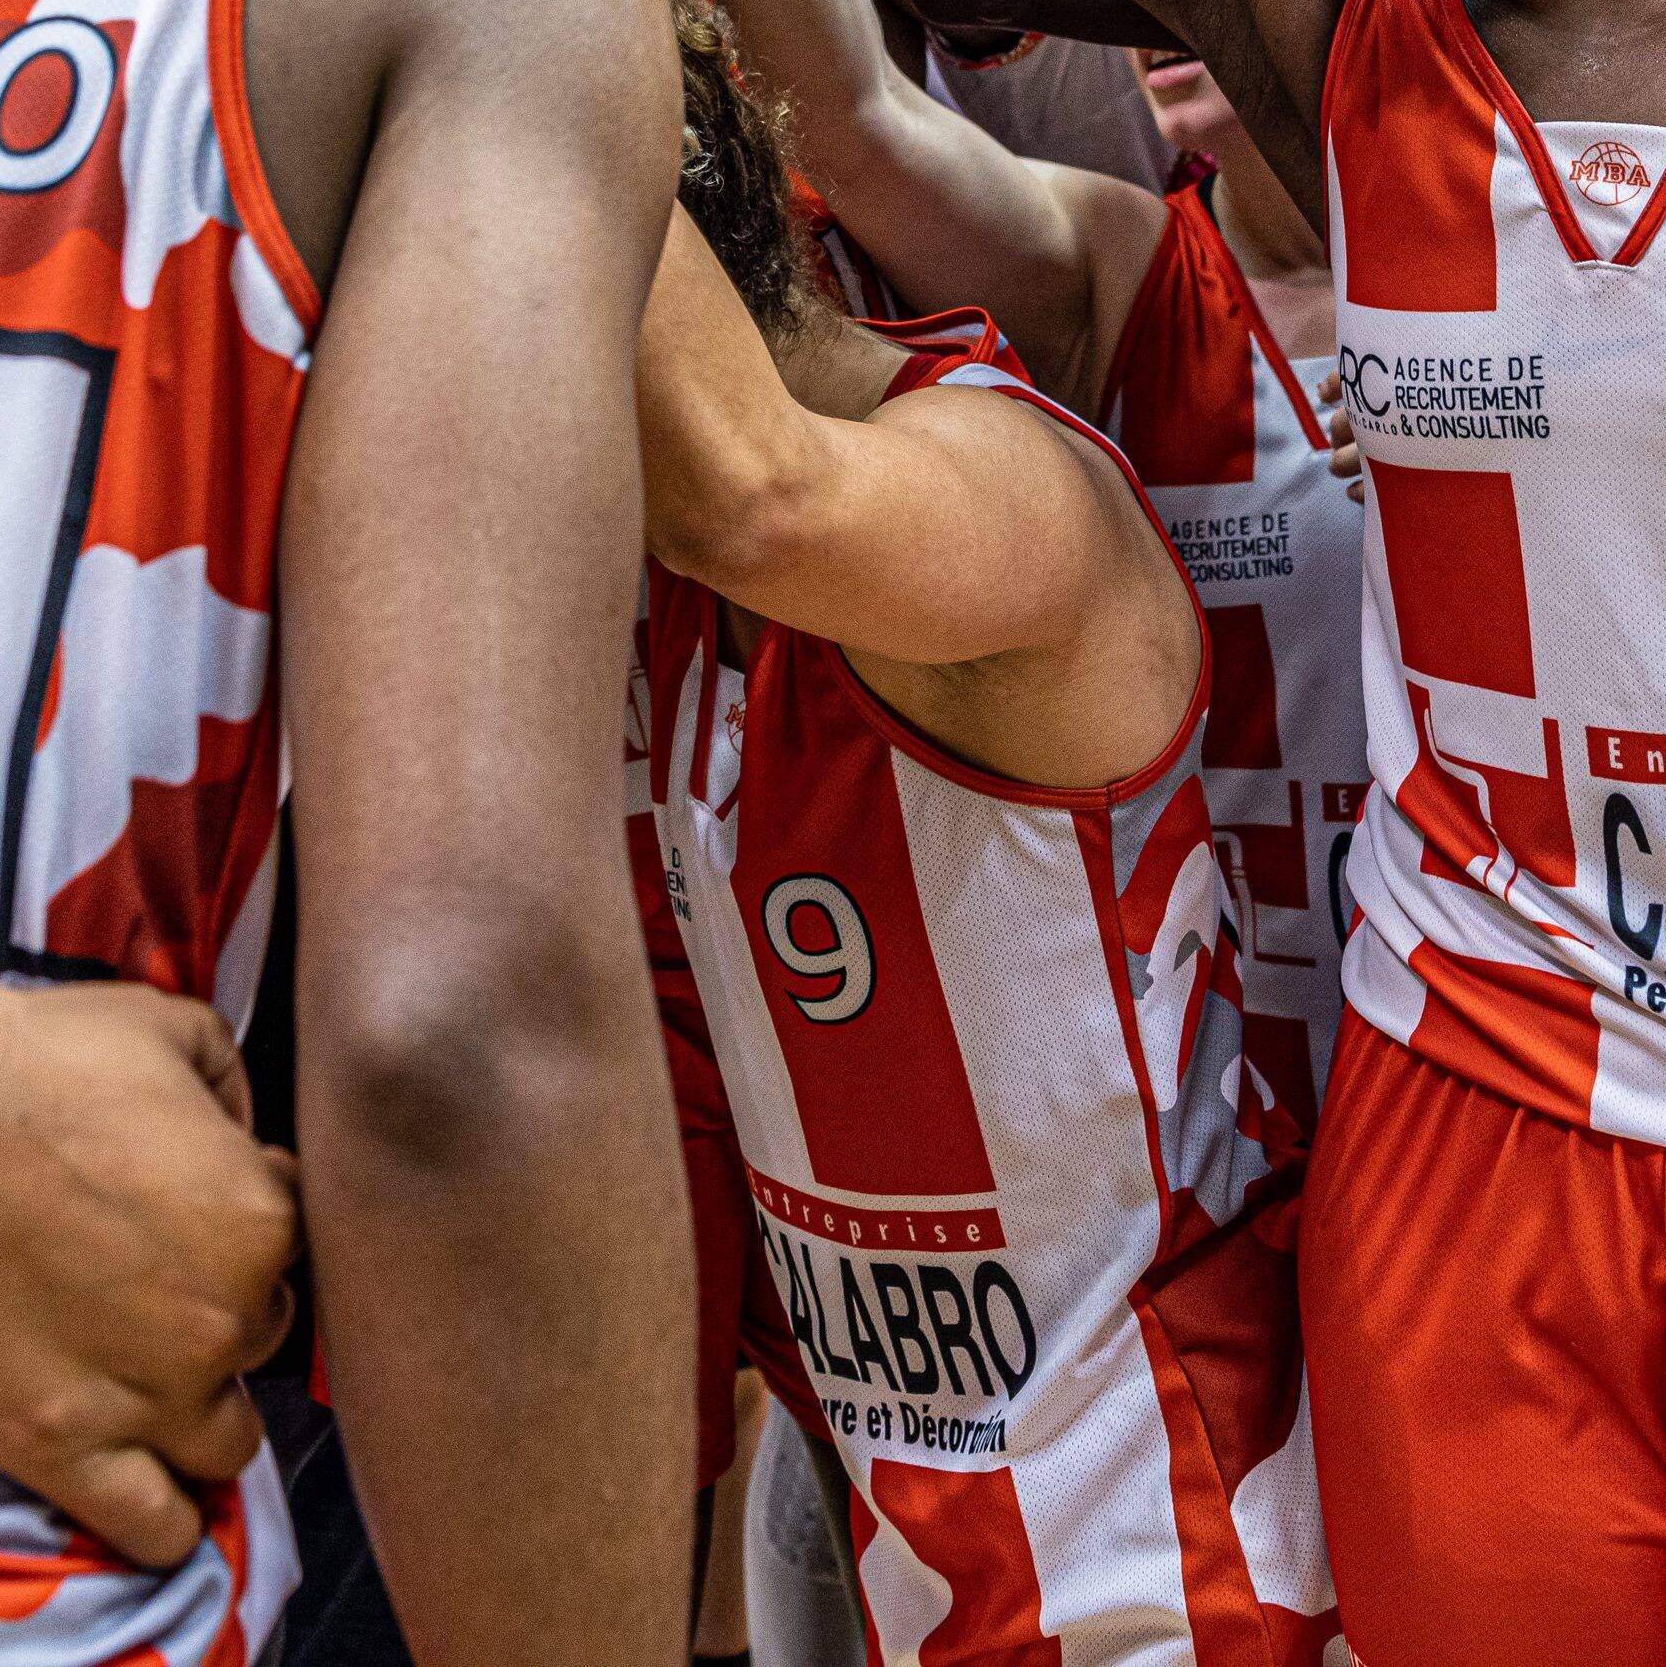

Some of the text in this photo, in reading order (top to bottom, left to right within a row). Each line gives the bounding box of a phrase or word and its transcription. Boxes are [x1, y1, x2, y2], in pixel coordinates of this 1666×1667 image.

[1569, 160, 1651, 188] MBA
[1394, 355, 1545, 383] AGENCE DE
[1395, 384, 1545, 411] RECRUTEMENT
[1400, 413, 1551, 440] & CONSULTING
[1170, 512, 1290, 542] AGENCE DE
[761, 872, 878, 1027] 9
[867, 1402, 893, 1442] et
